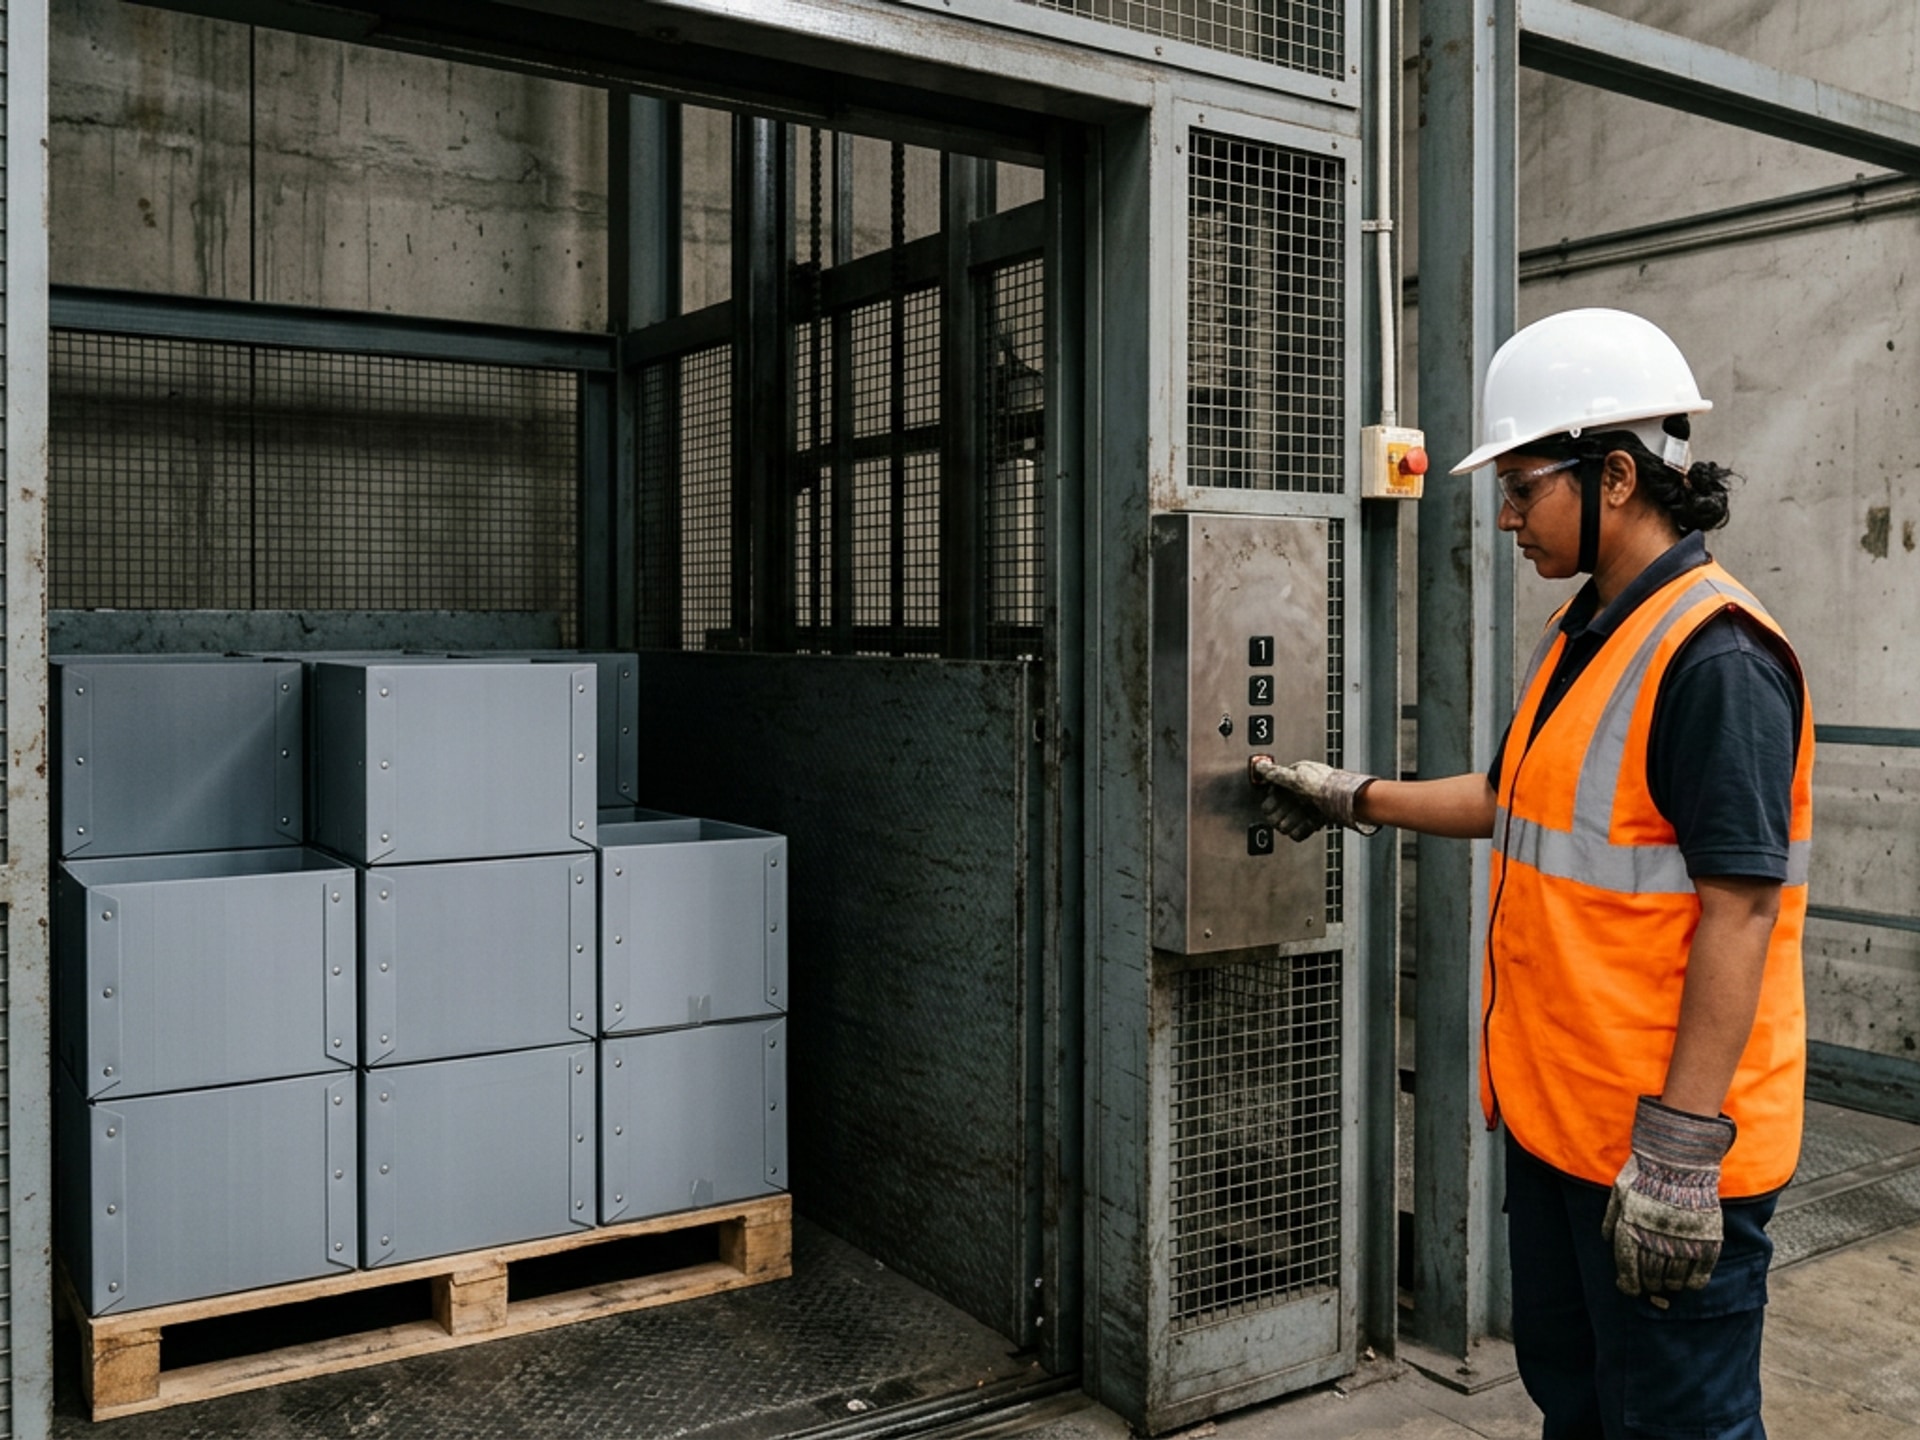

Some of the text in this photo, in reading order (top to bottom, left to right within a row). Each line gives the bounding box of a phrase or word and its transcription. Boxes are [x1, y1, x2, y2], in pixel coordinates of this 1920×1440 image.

[1258, 639, 1266, 660] 1
[1257, 679, 1267, 699] 2
[1256, 718, 1267, 739] 3
